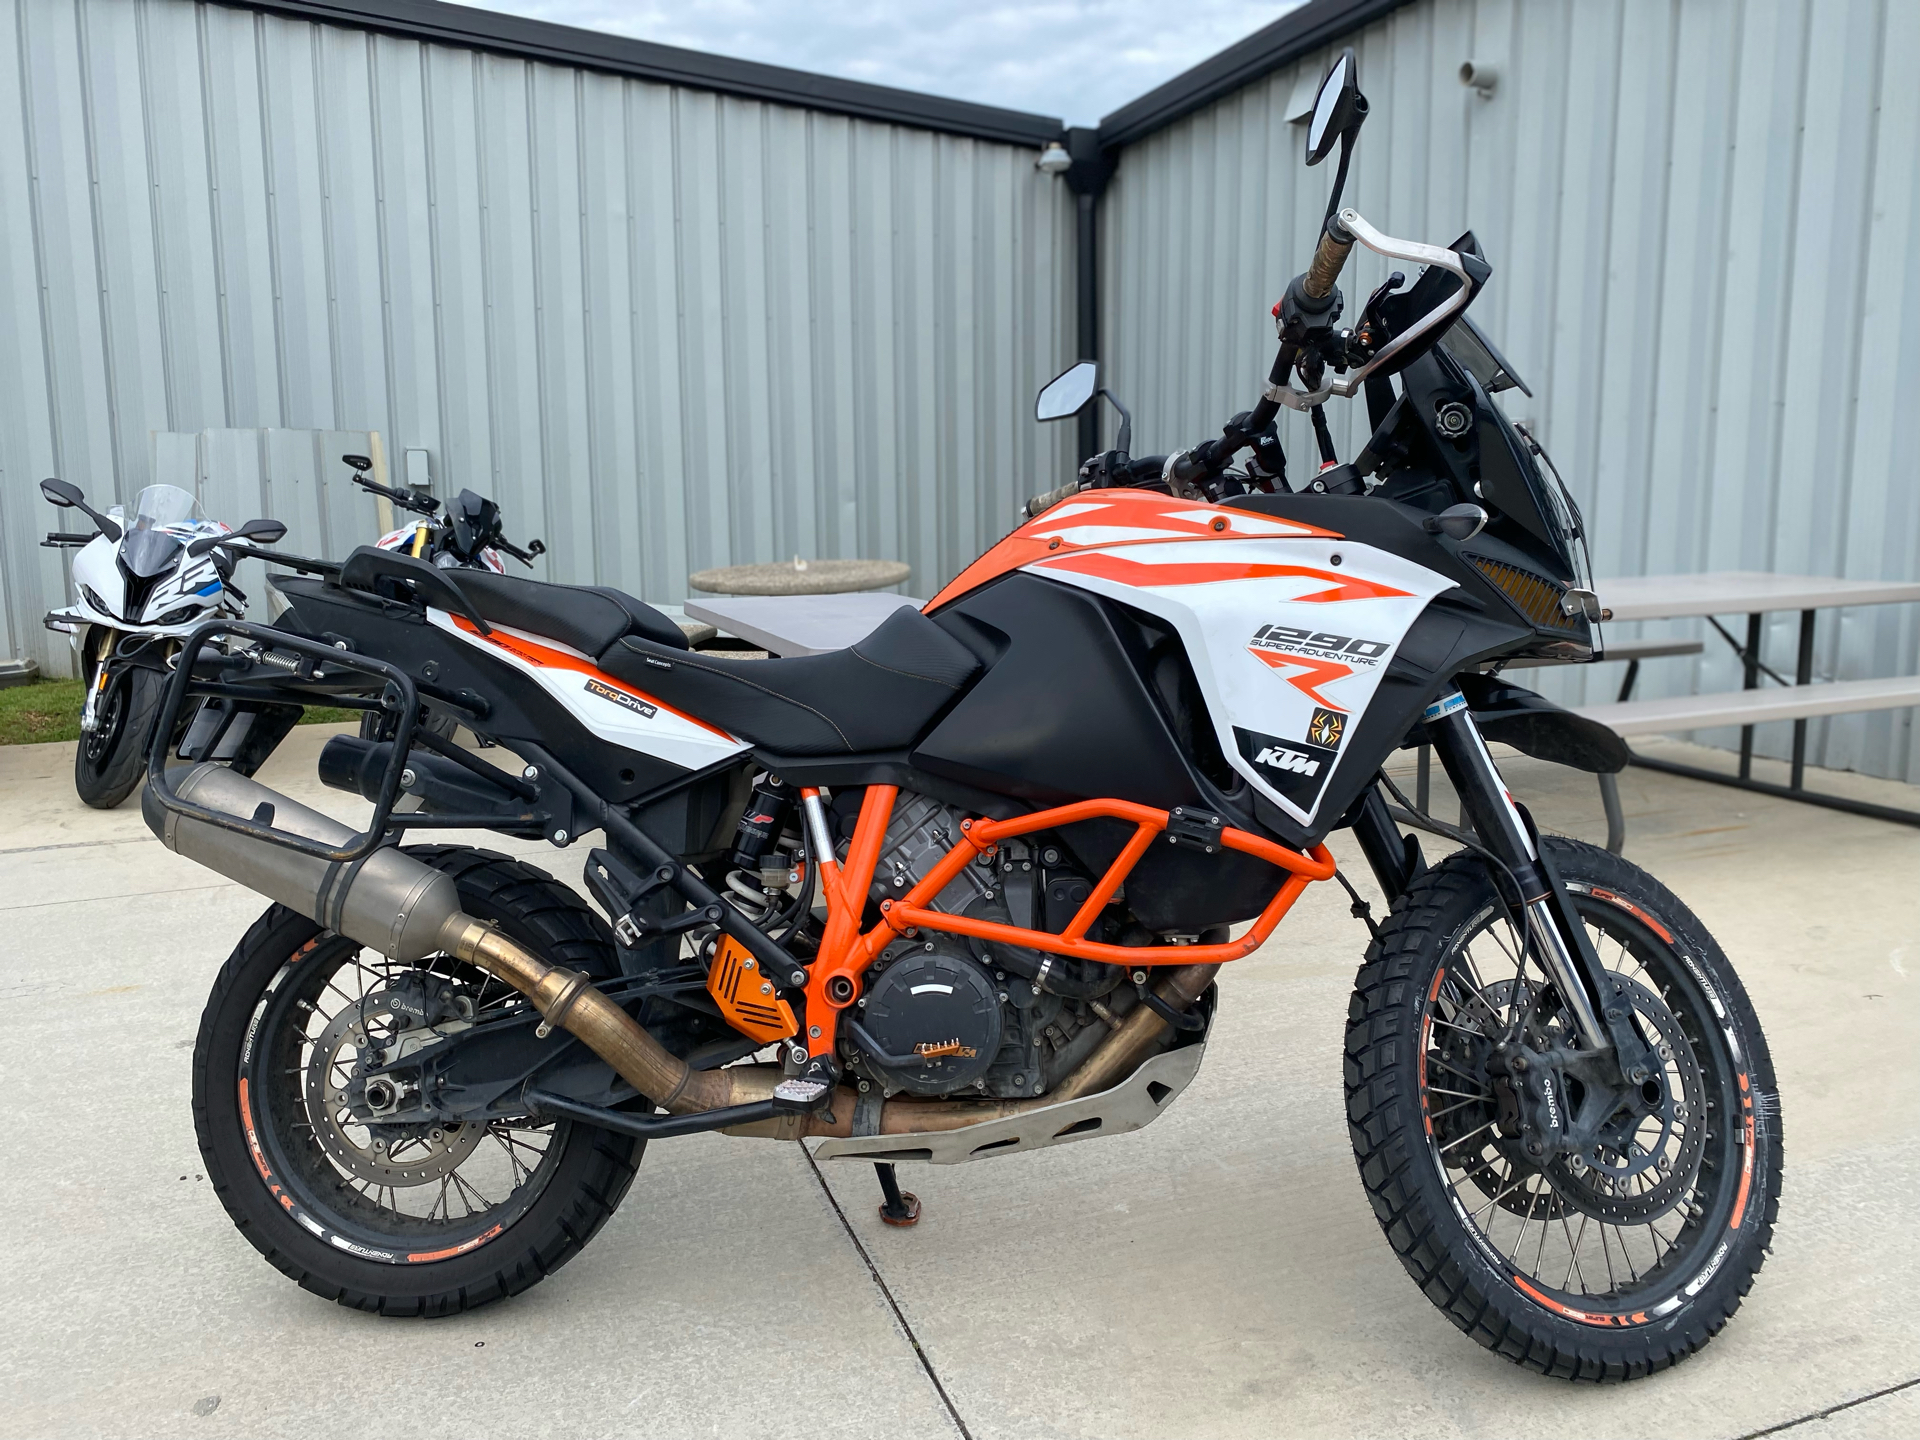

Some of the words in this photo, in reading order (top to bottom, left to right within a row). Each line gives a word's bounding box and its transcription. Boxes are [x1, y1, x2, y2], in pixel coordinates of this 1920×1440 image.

[1249, 639, 1379, 666] SUPER-ADVENTURE
[1252, 624, 1391, 658] 1290
[589, 681, 654, 716] TorqDrive
[1254, 746, 1321, 777] KTM
[1682, 955, 1716, 999] ADVENTURE
[243, 1018, 259, 1063] ADVENTURE
[1543, 1078, 1559, 1128] brembo
[349, 1243, 394, 1258] ADVENTURE
[1696, 1241, 1728, 1284] ADVENTURE
